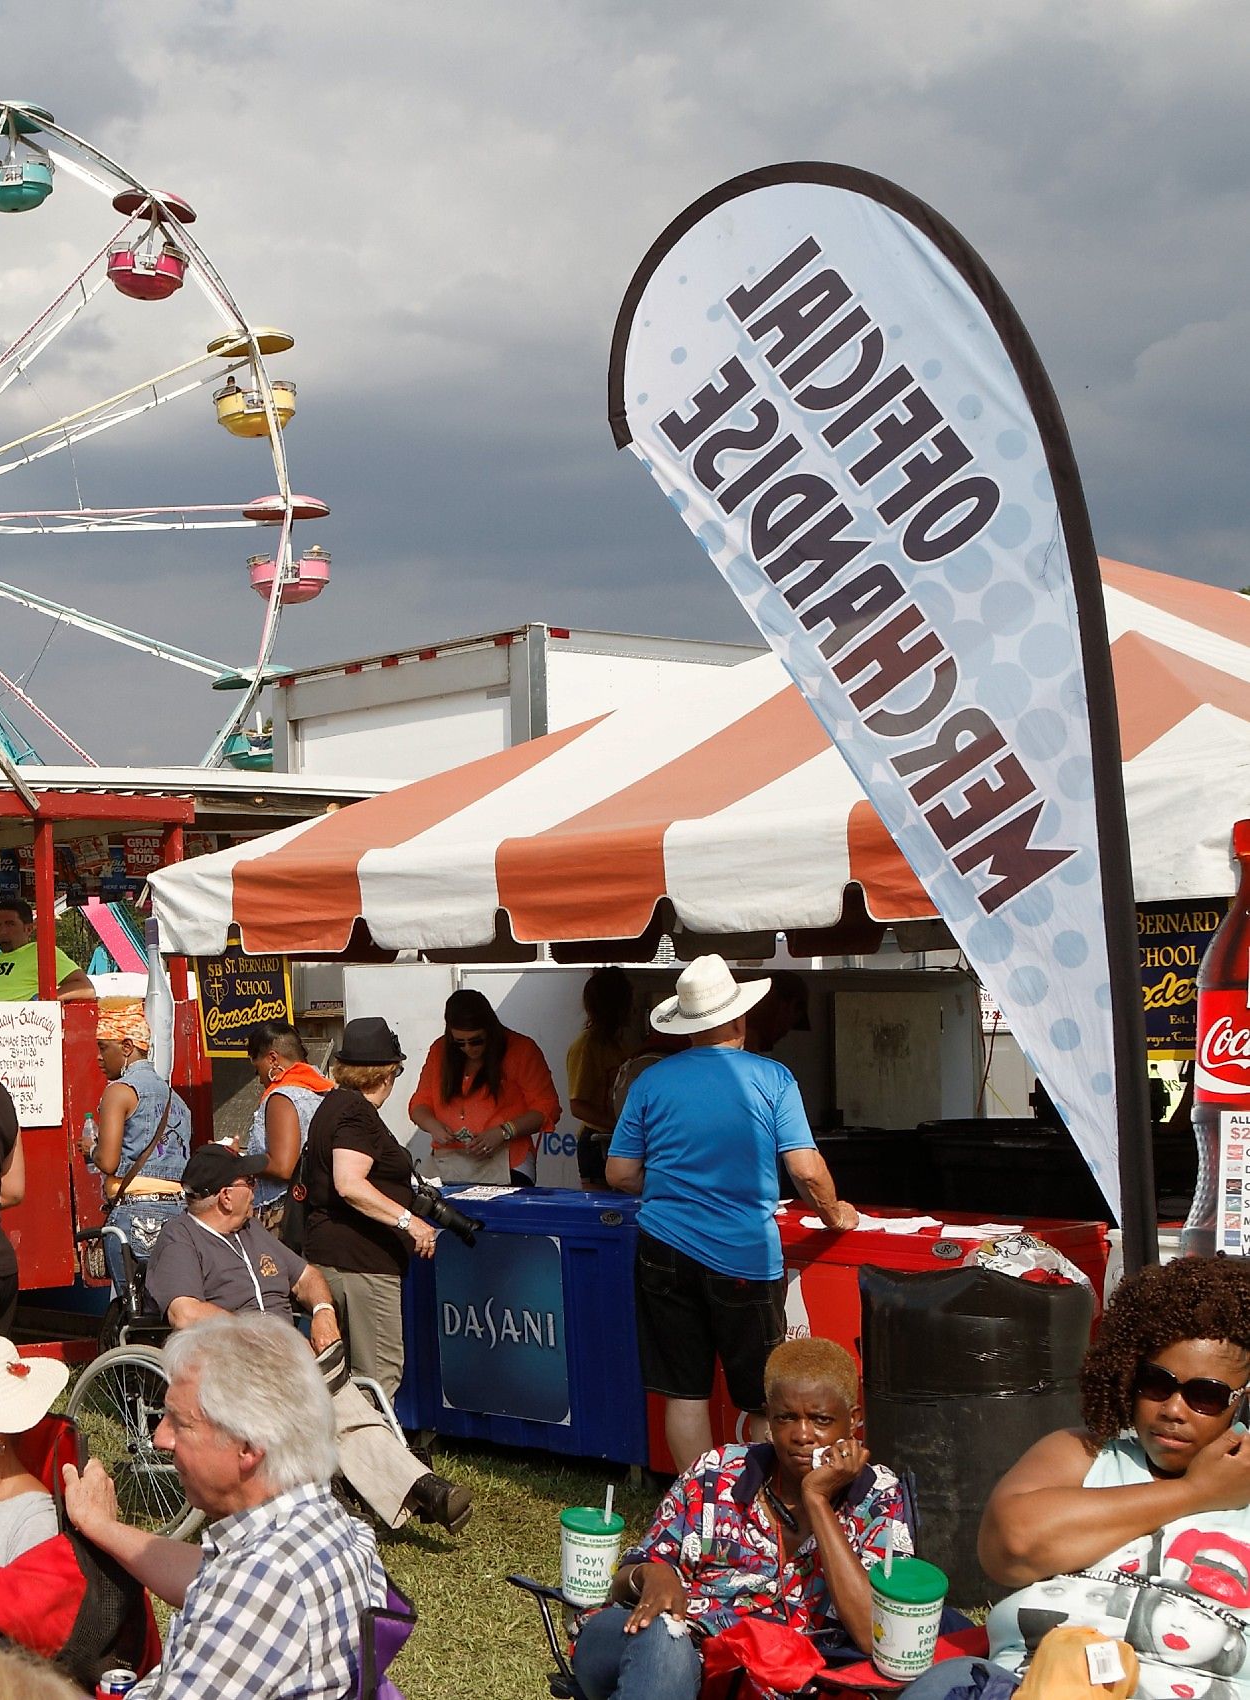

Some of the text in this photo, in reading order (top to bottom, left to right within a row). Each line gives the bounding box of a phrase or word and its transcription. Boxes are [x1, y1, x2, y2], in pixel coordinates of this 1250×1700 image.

[127, 838, 160, 848] GRAB
[127, 855, 160, 865] BUDS
[1139, 945, 1200, 968] CHOOL
[208, 963, 223, 977] SB
[238, 957, 280, 973] BERNARD
[235, 979, 273, 996] SCHOOL
[205, 998, 287, 1036] Crusaders
[1, 1072, 36, 1092] Sunday
[443, 1297, 555, 1349] DASANI
[575, 1554, 605, 1568] ROY'S
[578, 1568, 602, 1577] FRESH
